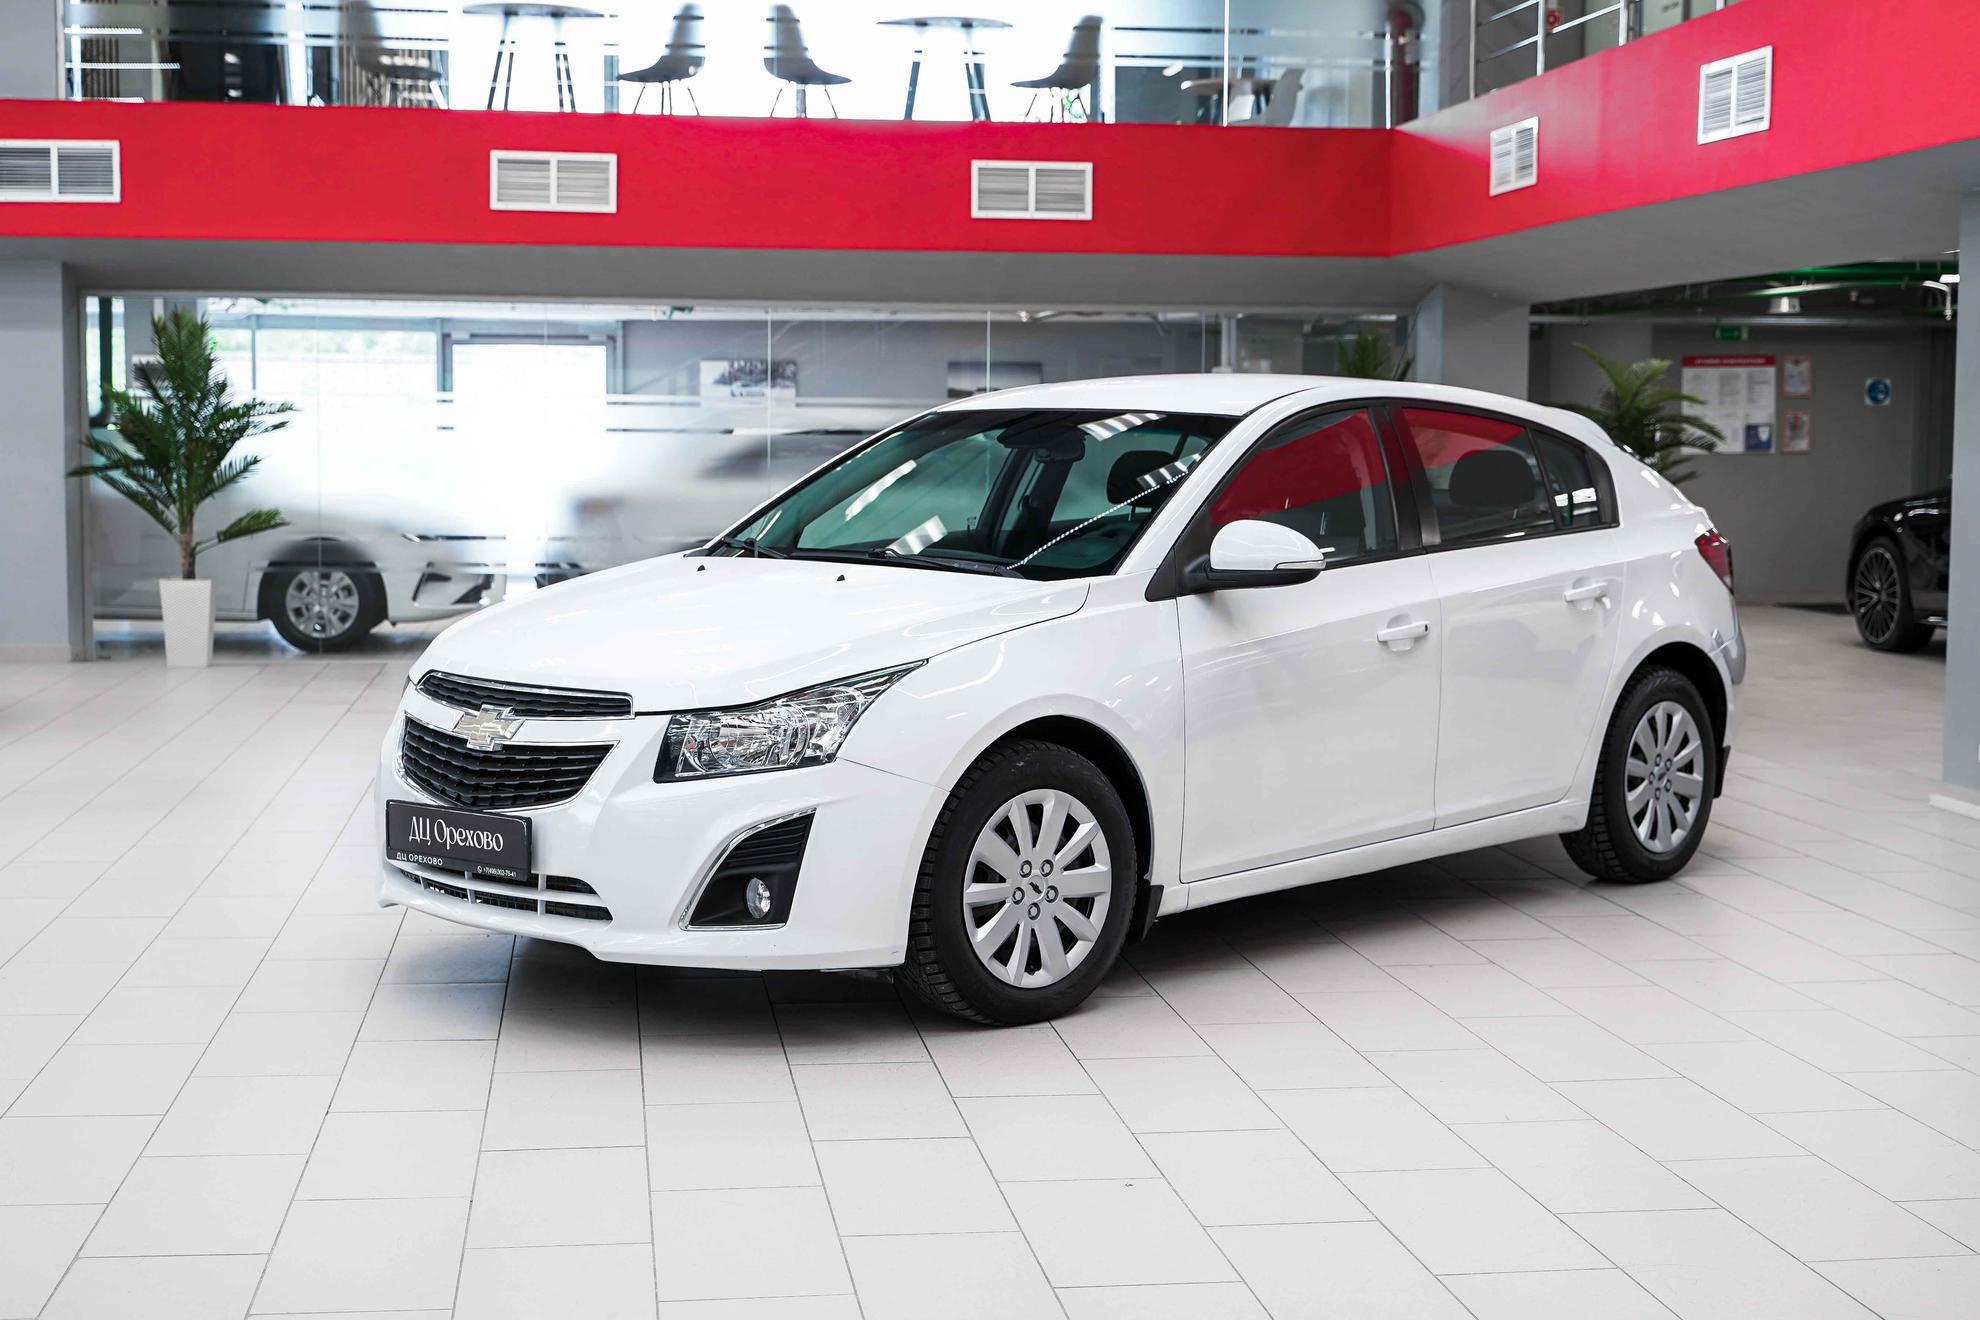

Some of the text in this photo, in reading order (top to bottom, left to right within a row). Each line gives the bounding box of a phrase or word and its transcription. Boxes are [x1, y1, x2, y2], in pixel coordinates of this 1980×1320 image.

[409, 816, 504, 852] ДЦ Орехово
[396, 852, 443, 866] ДЦ ОРЕХОВО
